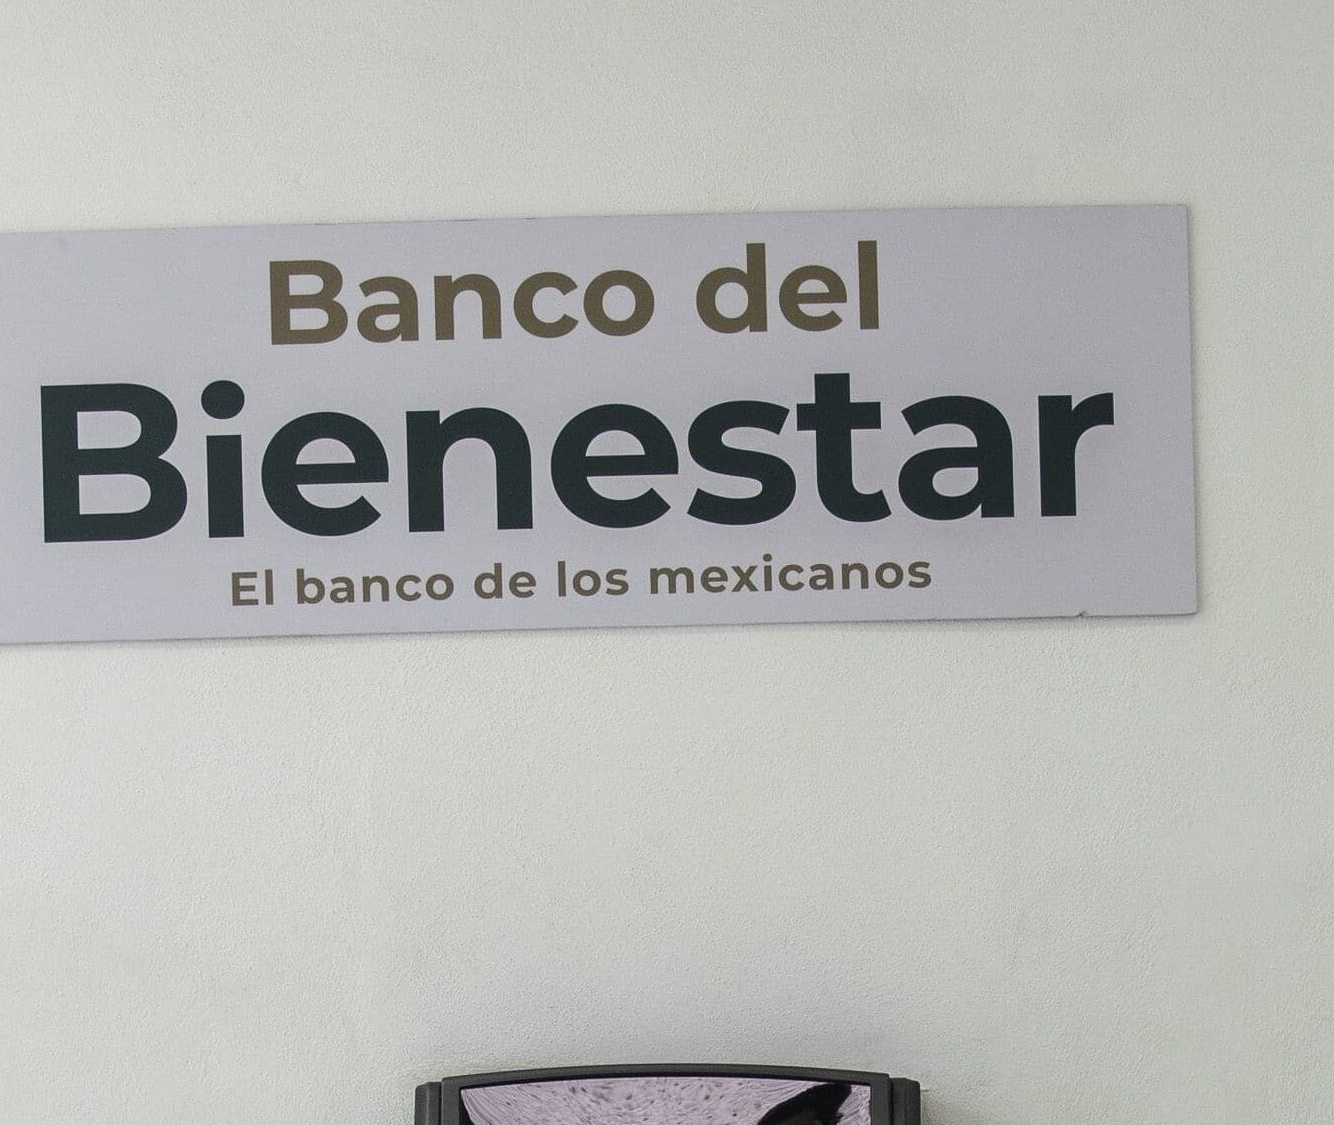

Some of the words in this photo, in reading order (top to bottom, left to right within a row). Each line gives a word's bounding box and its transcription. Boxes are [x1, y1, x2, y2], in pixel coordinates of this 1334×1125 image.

[270, 260, 654, 345] Banco
[696, 240, 879, 334] del
[41, 373, 1114, 543] Bienestar
[232, 569, 273, 606] El
[297, 568, 454, 604] banco
[474, 563, 536, 599] de
[558, 561, 628, 597] los
[650, 554, 931, 594] mexicanos
